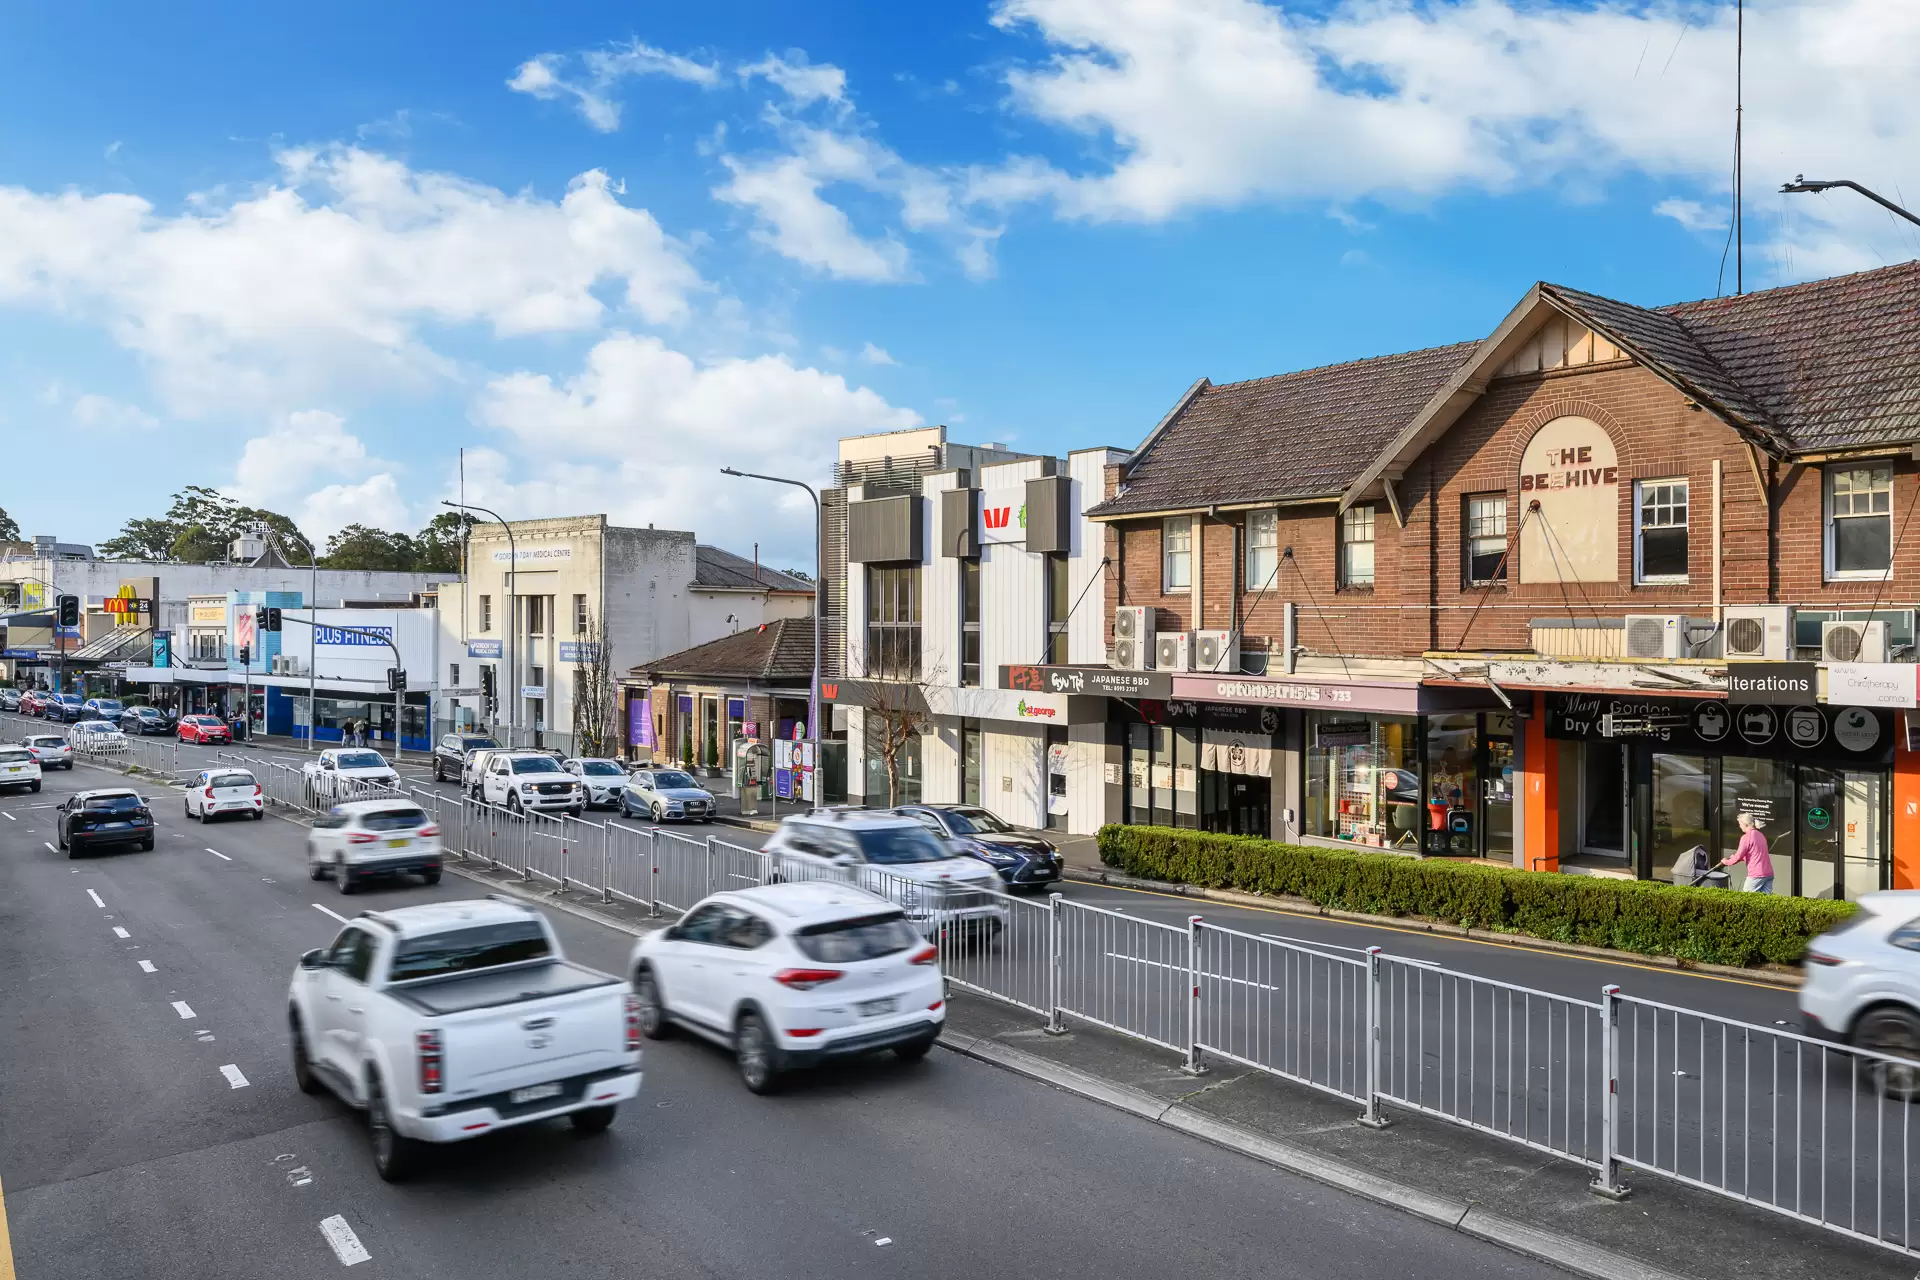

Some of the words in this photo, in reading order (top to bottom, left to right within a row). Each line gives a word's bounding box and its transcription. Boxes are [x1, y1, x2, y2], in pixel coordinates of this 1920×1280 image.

[1546, 446, 1592, 466] THE
[1520, 467, 1618, 491] BEEHIVE
[499, 552, 518, 560] GORDN
[523, 551, 533, 559] DAY
[533, 550, 553, 558] MEDICAL
[554, 549, 571, 558] CENTRE
[315, 627, 342, 644] PLUS
[345, 627, 392, 645] FITNESS
[1091, 675, 1131, 685] JAPANESE
[1132, 677, 1150, 686] BBQ
[1332, 690, 1352, 702] 733
[1204, 705, 1233, 714] JAPANESE
[1234, 706, 1247, 715] BBQ
[1556, 693, 1601, 718] Mary
[1609, 700, 1671, 717] Gordon
[1564, 718, 1591, 735] Dry
